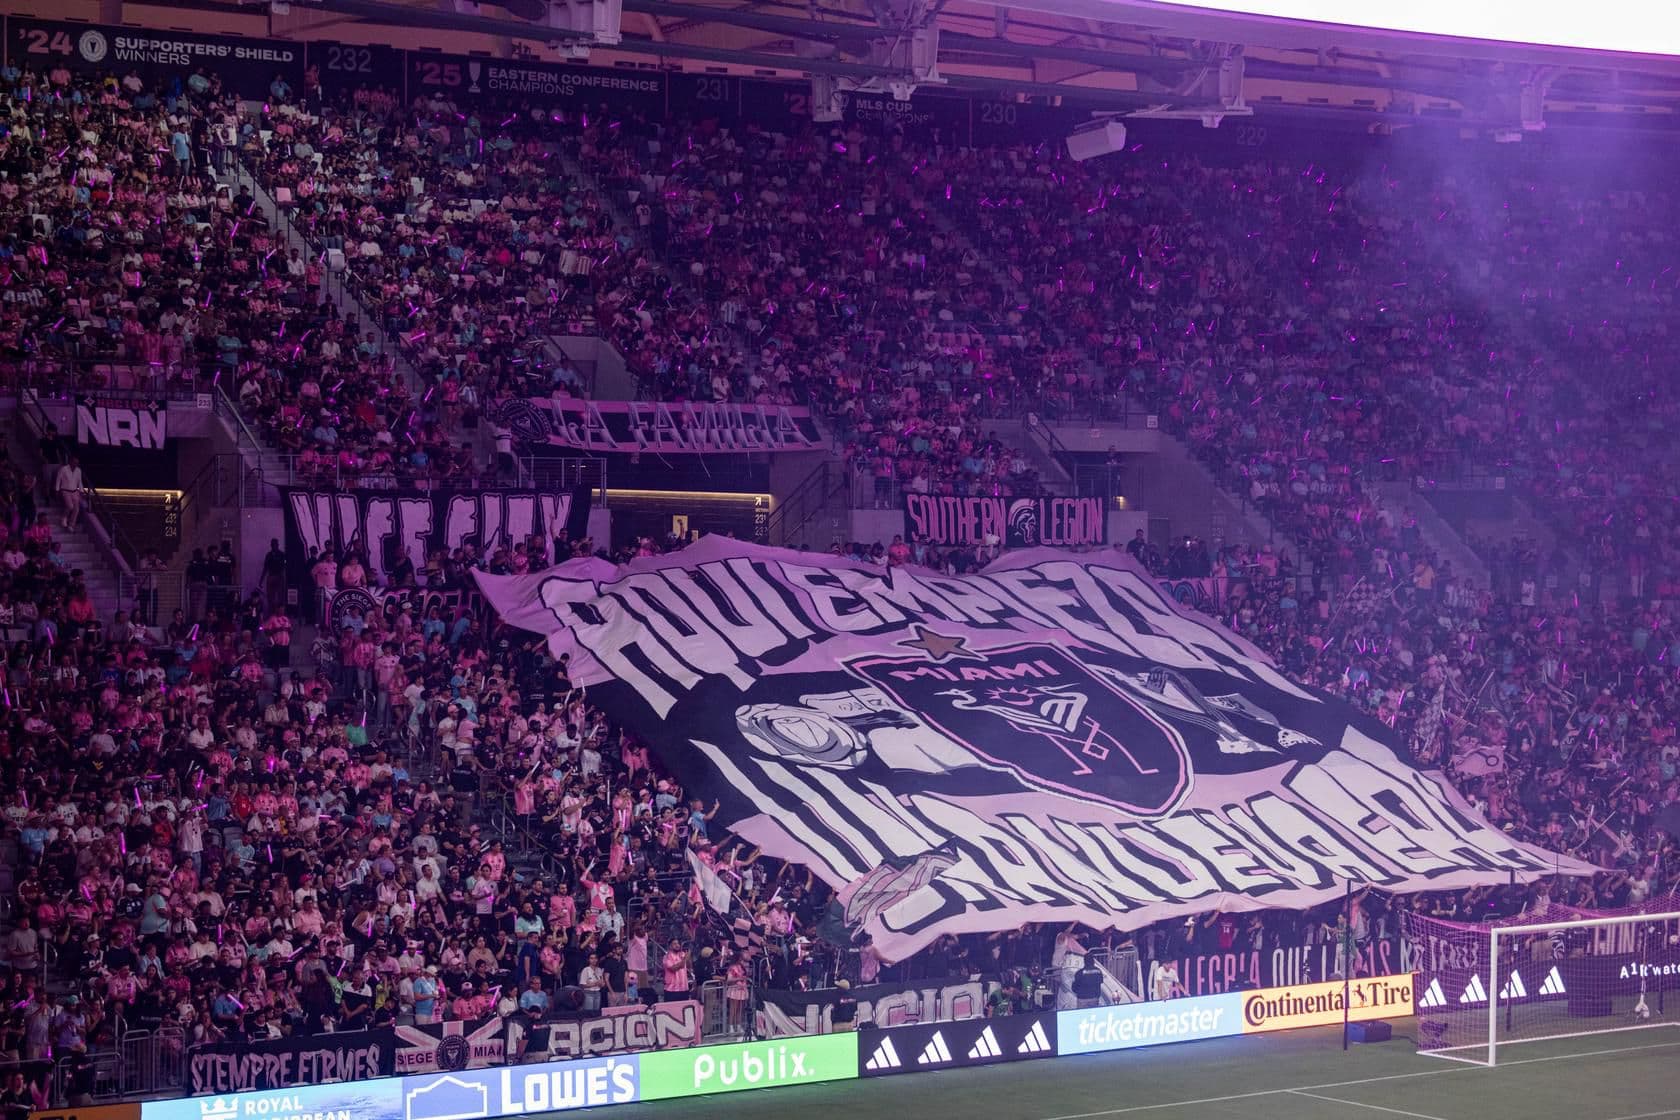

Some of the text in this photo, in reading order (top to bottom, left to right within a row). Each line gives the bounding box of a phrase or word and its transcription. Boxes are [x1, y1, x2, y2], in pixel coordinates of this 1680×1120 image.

[114, 36, 294, 63] SUPPORTERS' SHIELD
[114, 48, 191, 66] WINNERS
[327, 46, 372, 73] 232
[488, 67, 659, 92] EASTERN CONFERENCE
[488, 78, 575, 96] CHAMPIONS
[696, 78, 729, 100] 231
[856, 99, 913, 113] MLS CUP
[980, 103, 1017, 125] 230
[906, 493, 1103, 546] SOUTHERN LEGION
[889, 659, 1060, 682] MIAMI
[1367, 982, 1411, 1008] Tire
[1078, 1003, 1223, 1046] ticketmaster
[397, 1052, 433, 1065] SIEGE
[190, 1050, 293, 1096] SIEMPRE
[501, 1058, 636, 1114] LOWE'S
[245, 1095, 303, 1115] ROYAL
